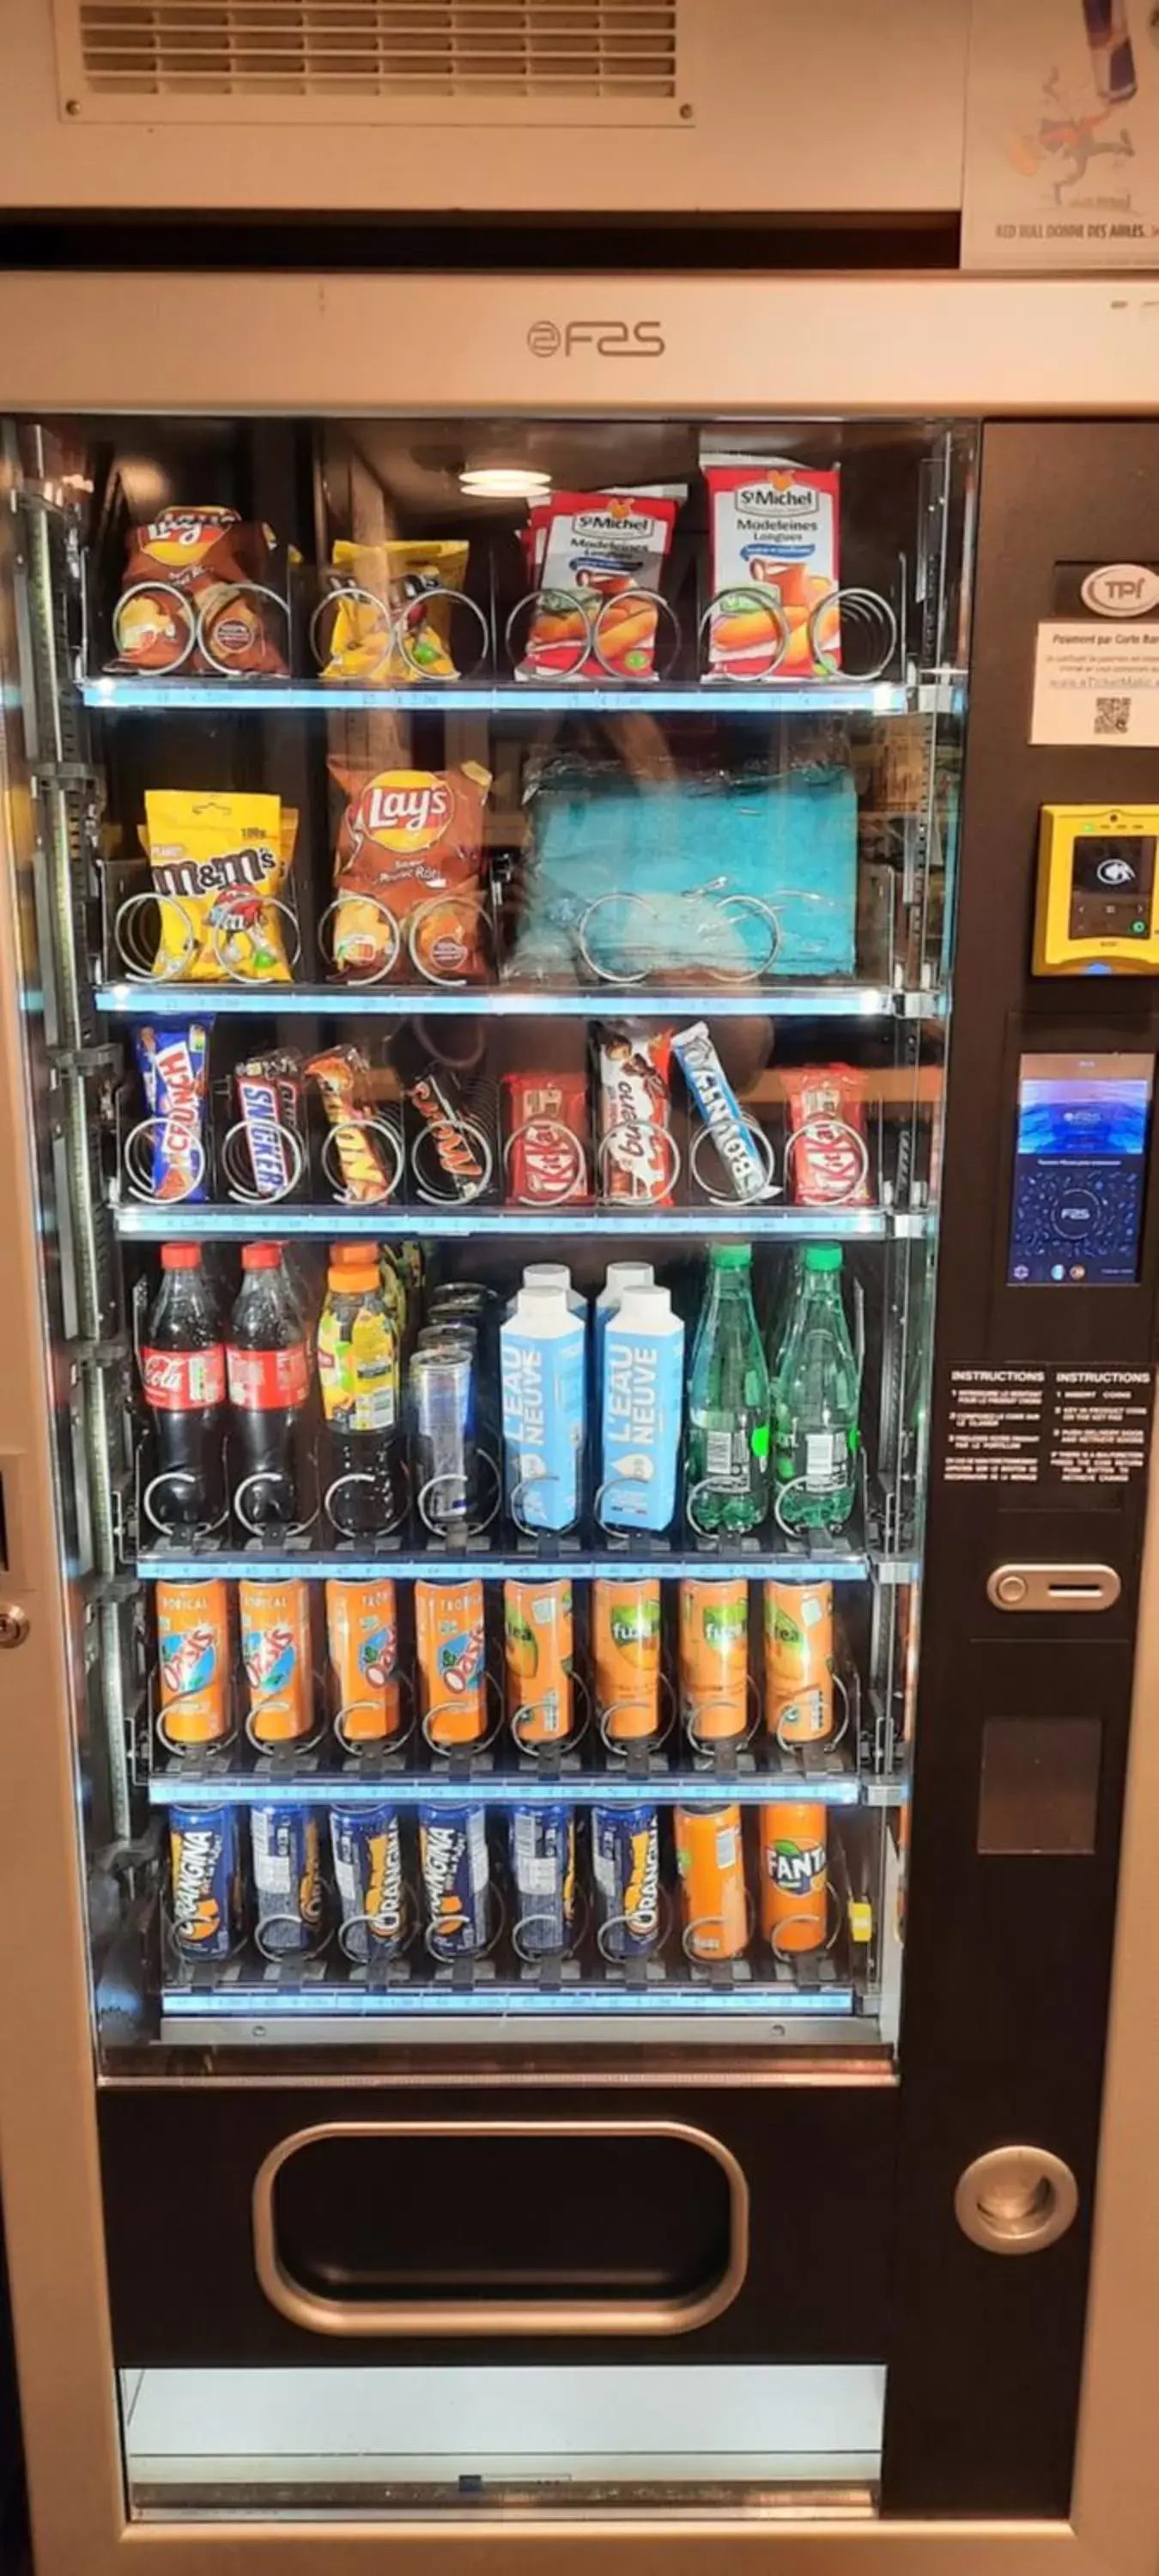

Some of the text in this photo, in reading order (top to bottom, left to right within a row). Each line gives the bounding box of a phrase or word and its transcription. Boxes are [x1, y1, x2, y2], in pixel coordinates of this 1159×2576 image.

[368, 785, 447, 830] Lay's
[502, 1341, 525, 1443] L'EAU
[521, 1348, 545, 1446] NEUVE
[608, 1343, 634, 1444] L'EAU
[631, 1347, 658, 1445] NEUVE
[951, 1370, 1045, 1382] INSTRUCTIONS
[1056, 1371, 1150, 1383] INSTRUCTIONS
